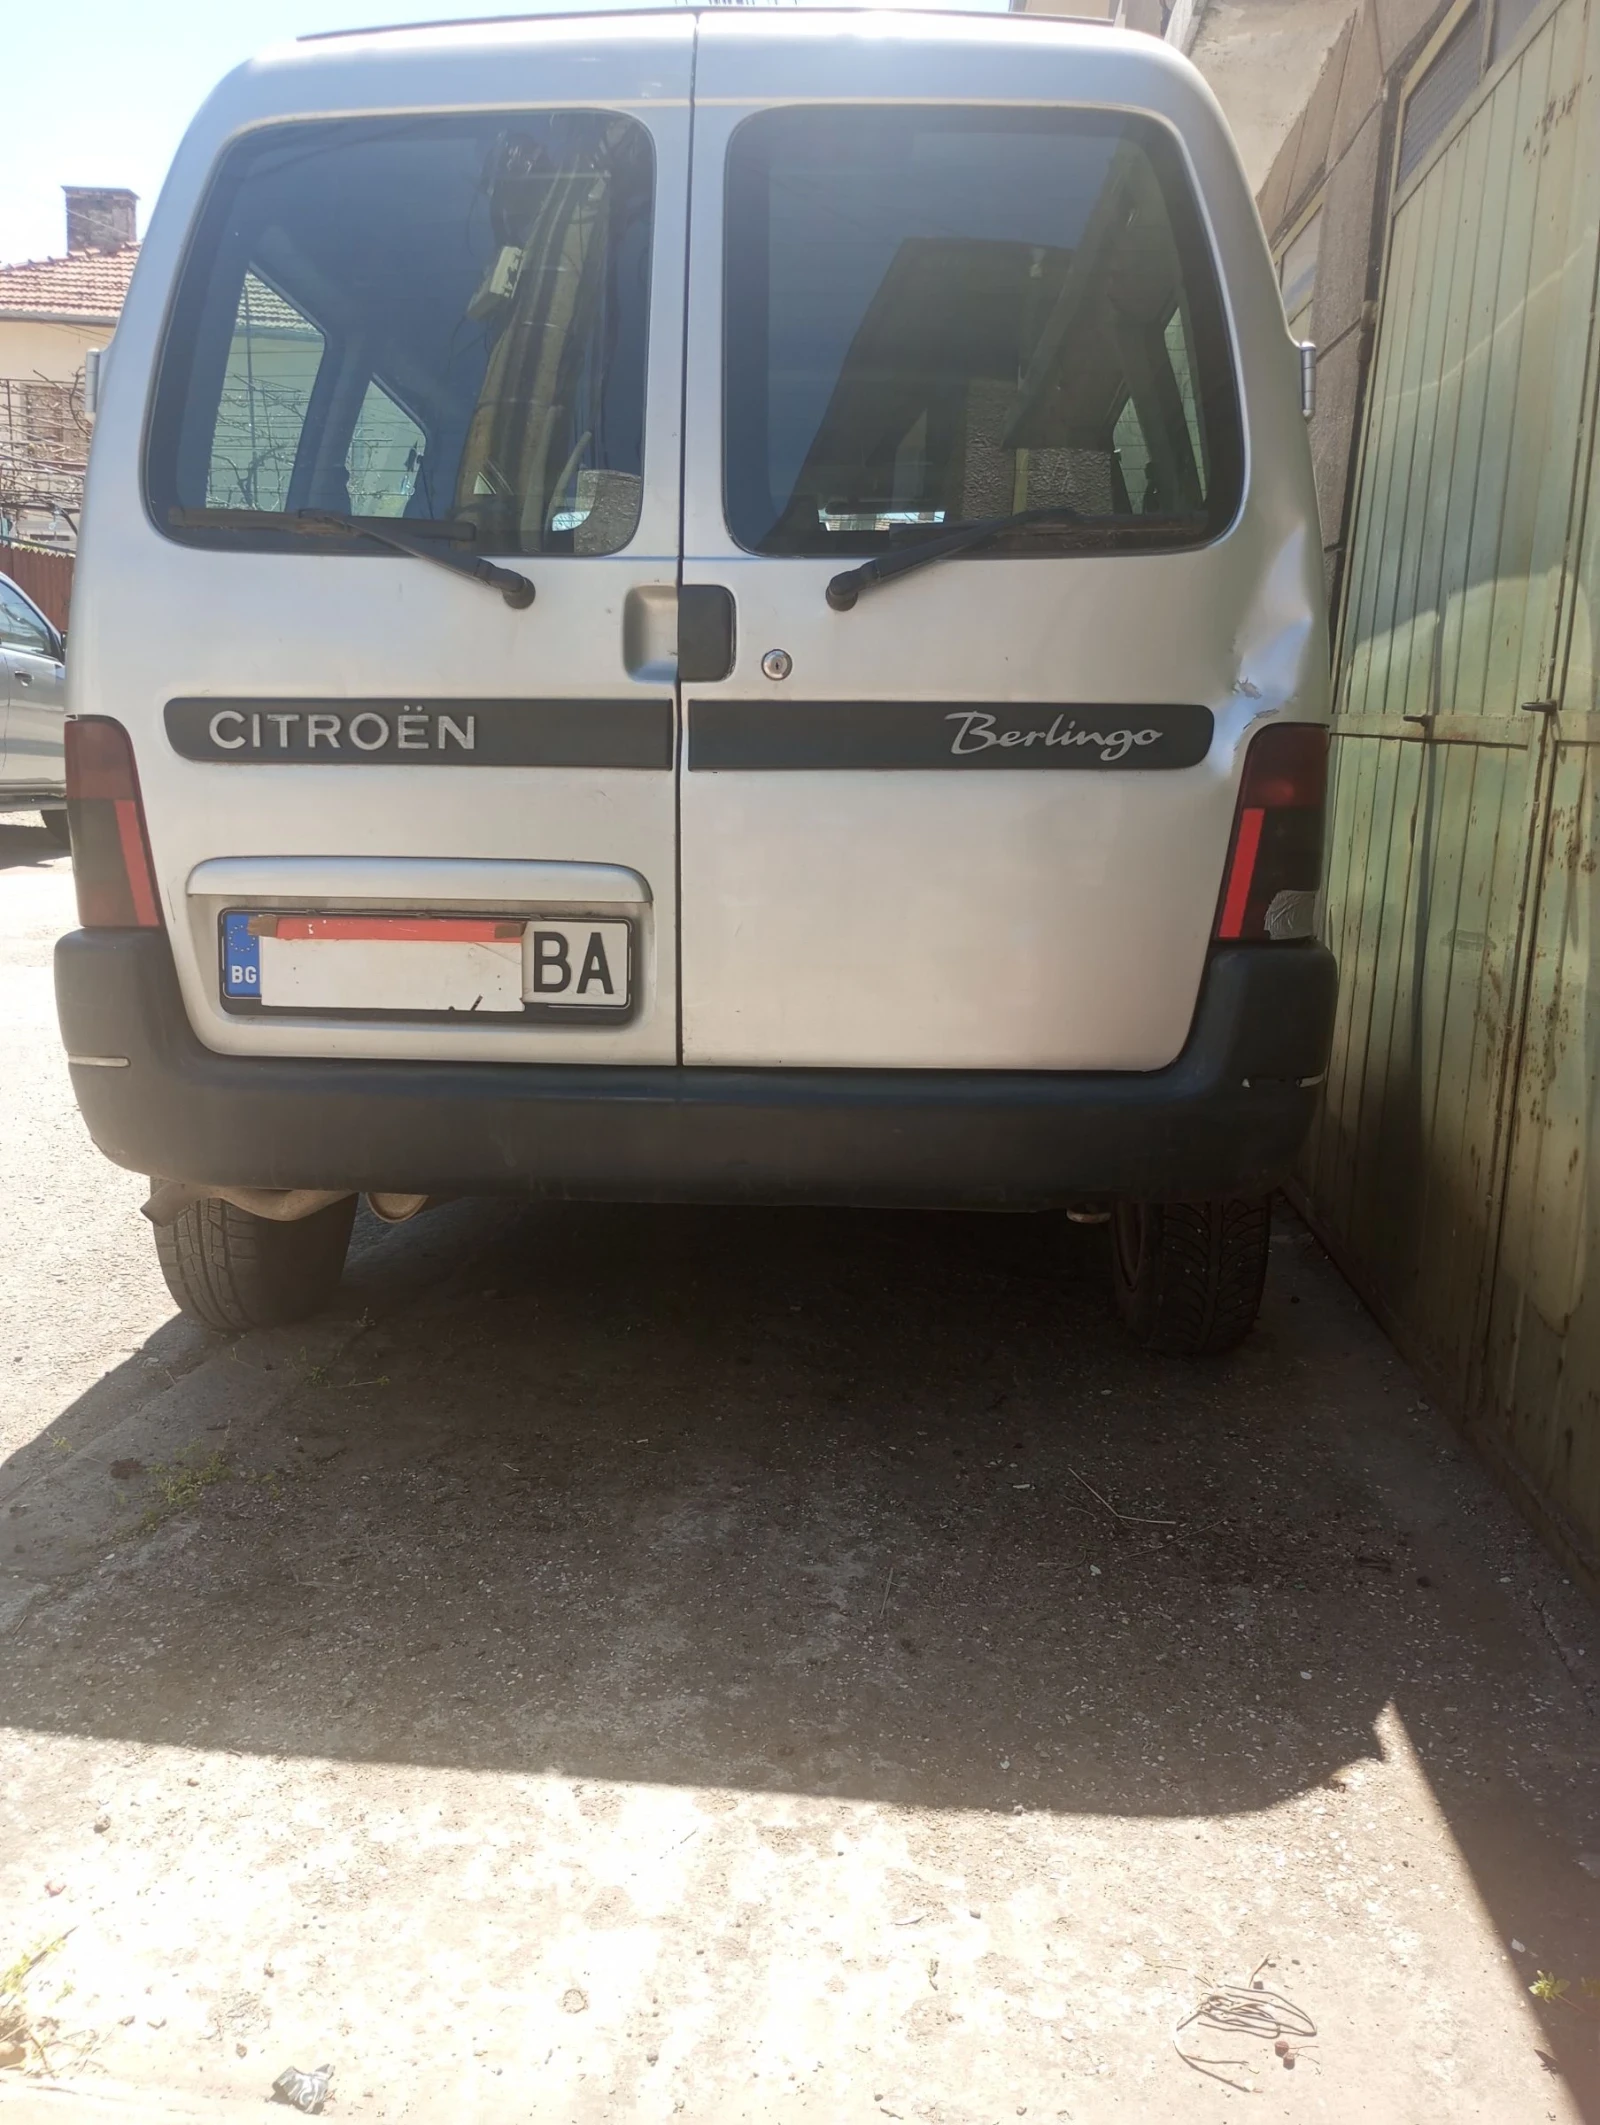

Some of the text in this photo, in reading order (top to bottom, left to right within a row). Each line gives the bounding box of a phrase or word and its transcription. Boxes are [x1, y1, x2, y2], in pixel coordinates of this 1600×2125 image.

[209, 705, 475, 751] CITROËN
[944, 711, 1164, 761] Berlingo
[231, 965, 257, 985] BG
[533, 931, 614, 995] BA
